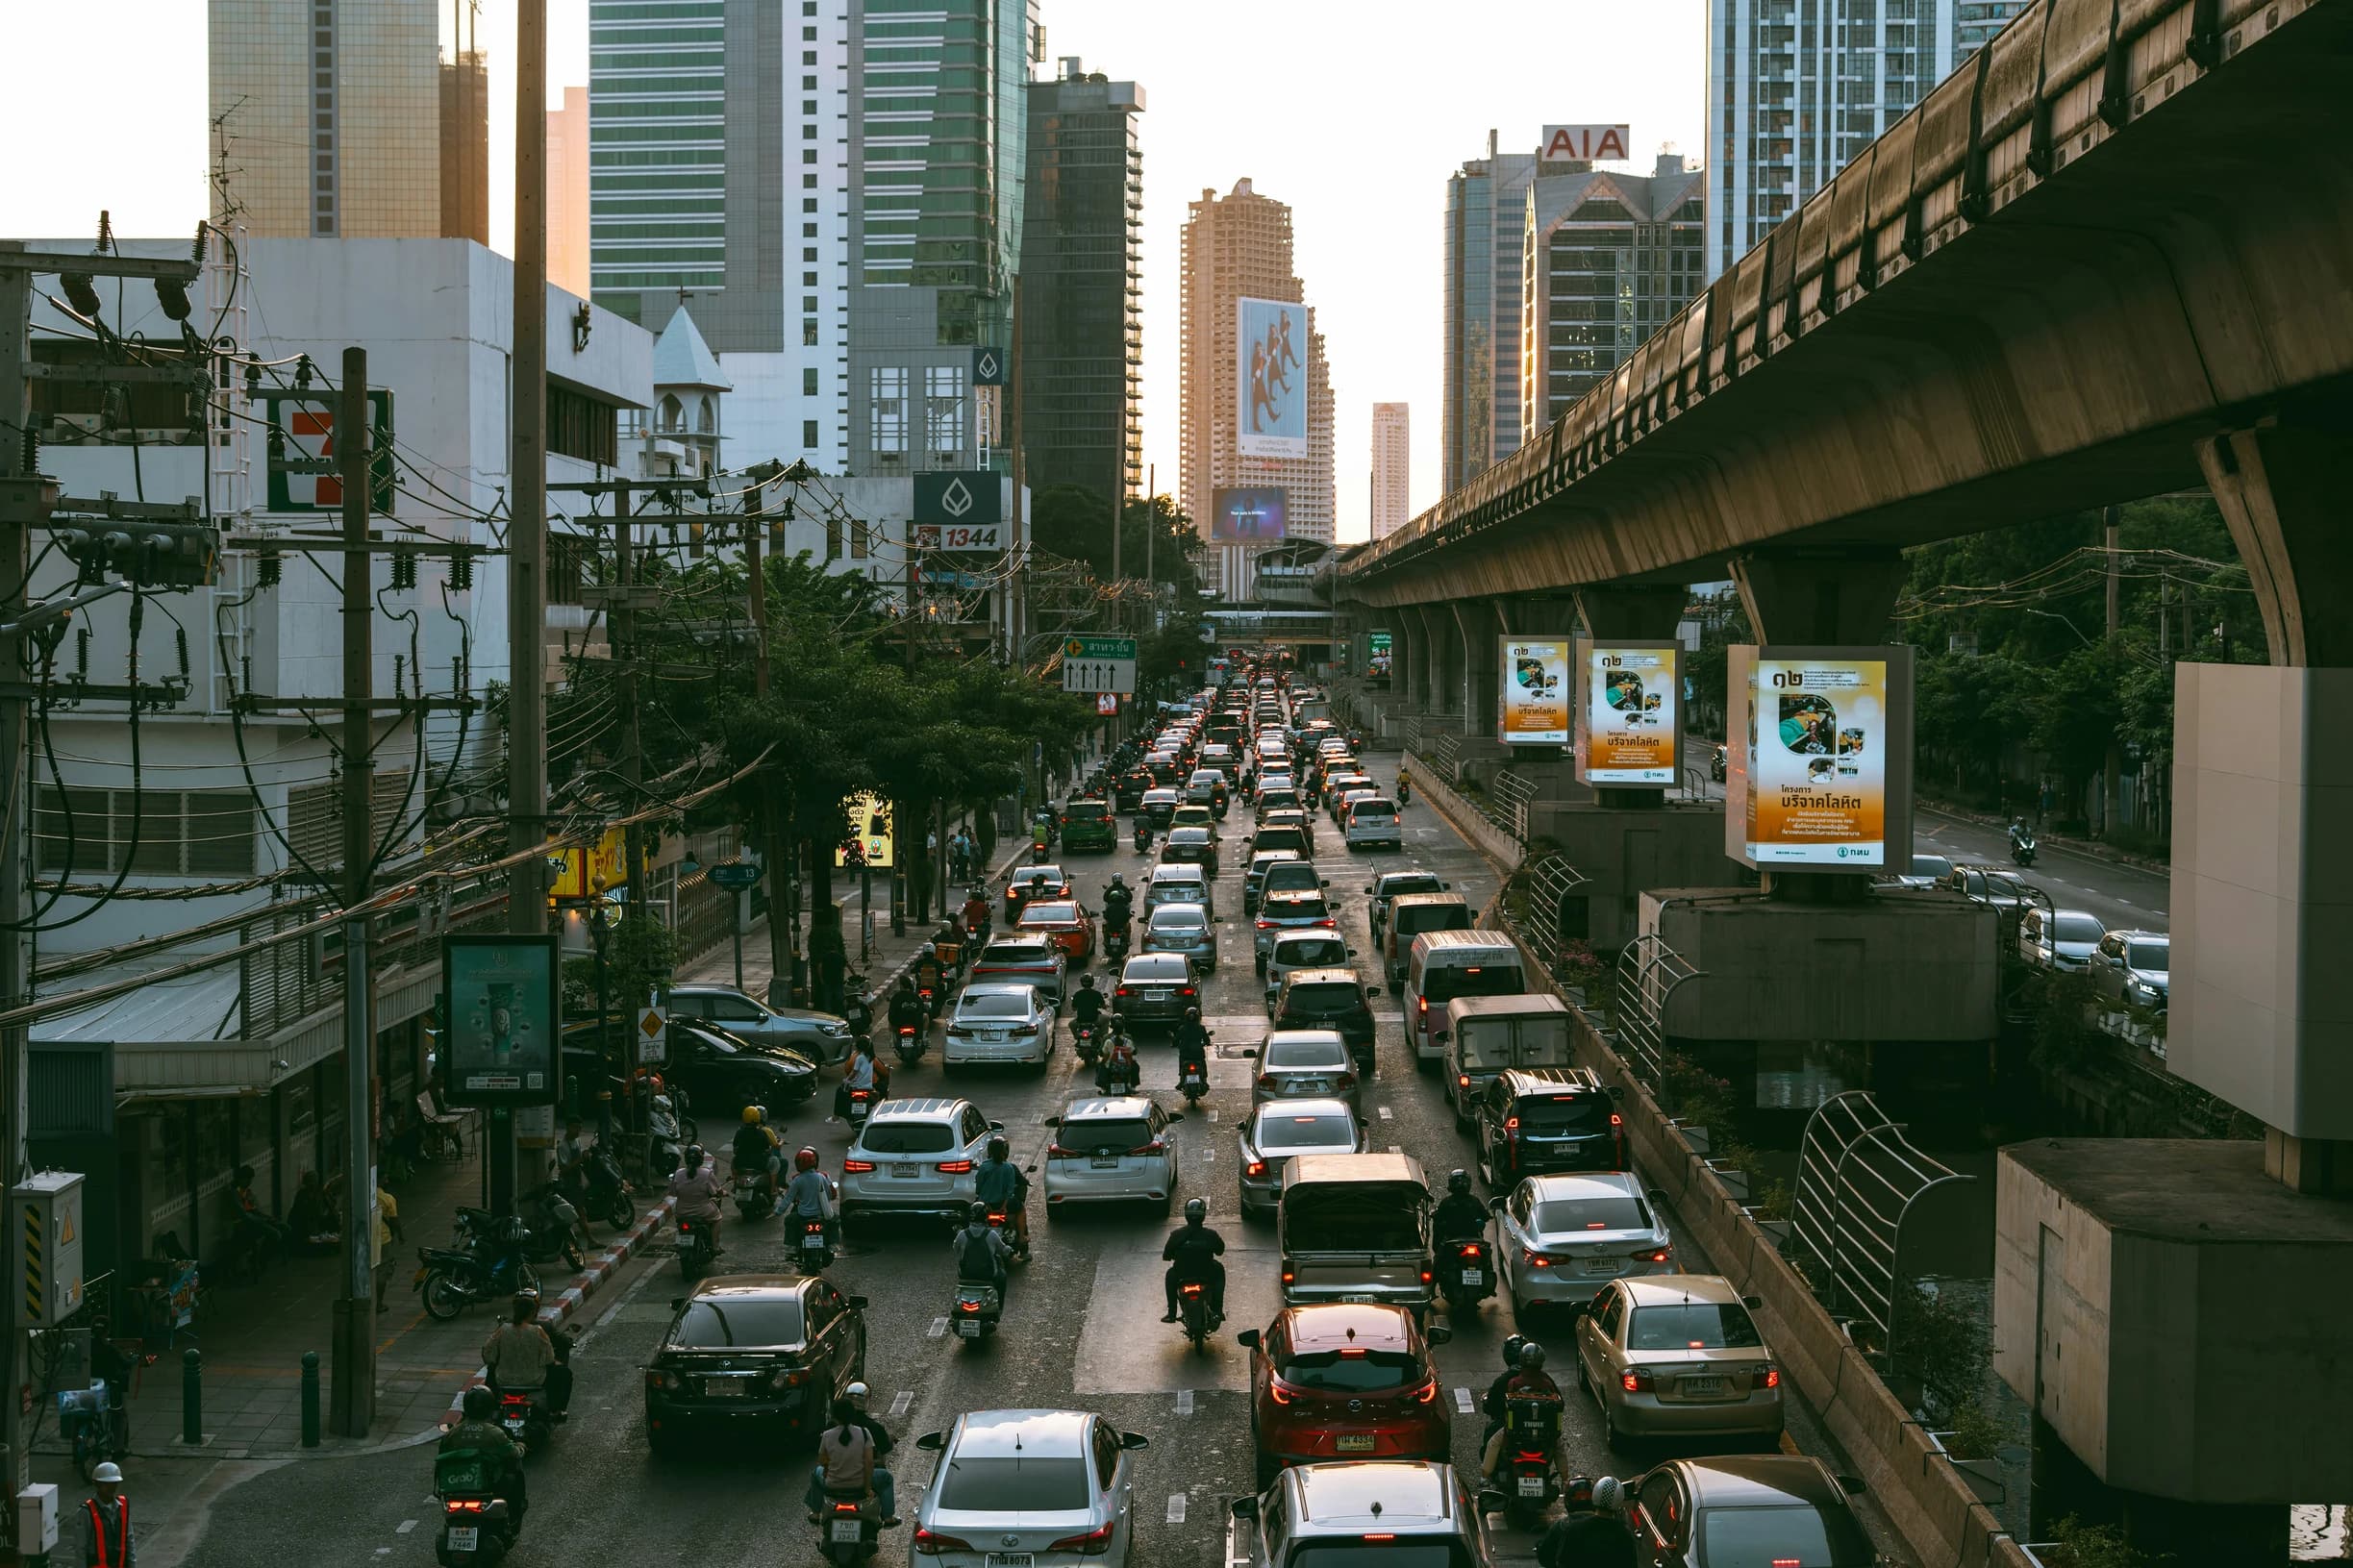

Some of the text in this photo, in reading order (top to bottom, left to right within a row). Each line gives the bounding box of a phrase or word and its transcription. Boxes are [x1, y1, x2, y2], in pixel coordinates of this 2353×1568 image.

[1546, 129, 1625, 158] AIA
[946, 528, 997, 547] 1344
[1607, 735, 1660, 747] บริจาคโลหิต
[1781, 784, 1812, 794] โครงการ
[1781, 793, 1862, 809] บริจาคโลหิต
[745, 868, 755, 878] 13
[448, 1472, 473, 1484] Grab
[1009, 1556, 1031, 1566] 8073
